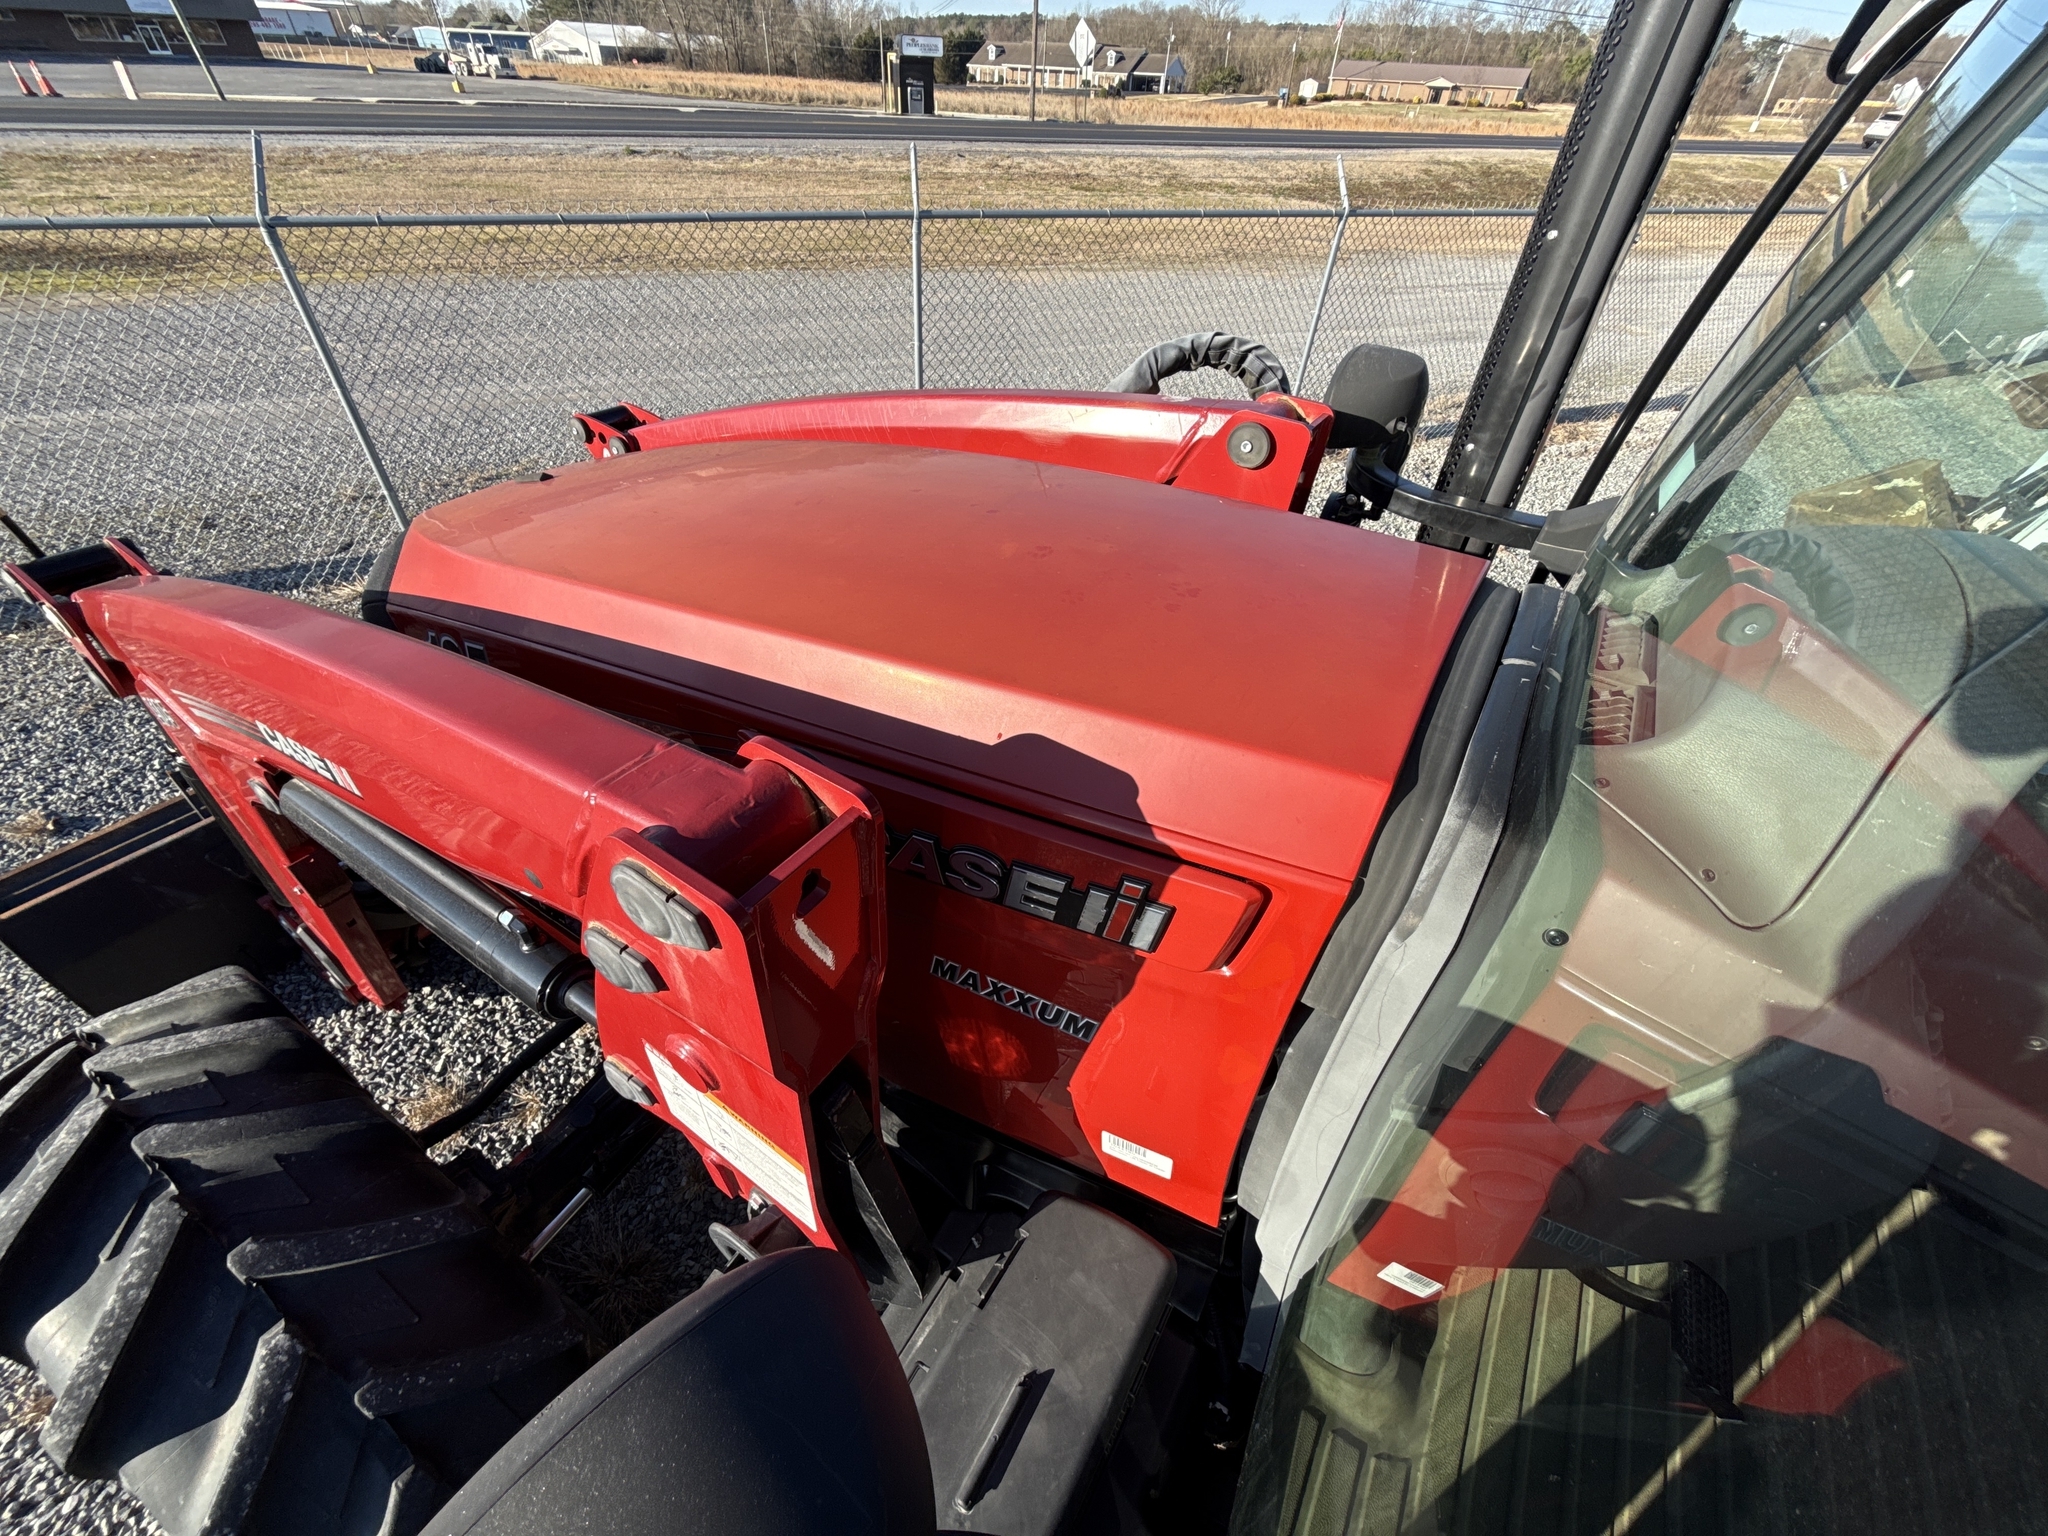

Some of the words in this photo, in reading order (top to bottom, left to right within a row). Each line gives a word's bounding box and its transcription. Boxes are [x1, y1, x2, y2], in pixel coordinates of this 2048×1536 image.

[255, 720, 336, 782] CASE
[885, 829, 1068, 921] ASE
[930, 955, 1100, 1043] MAXXUM
